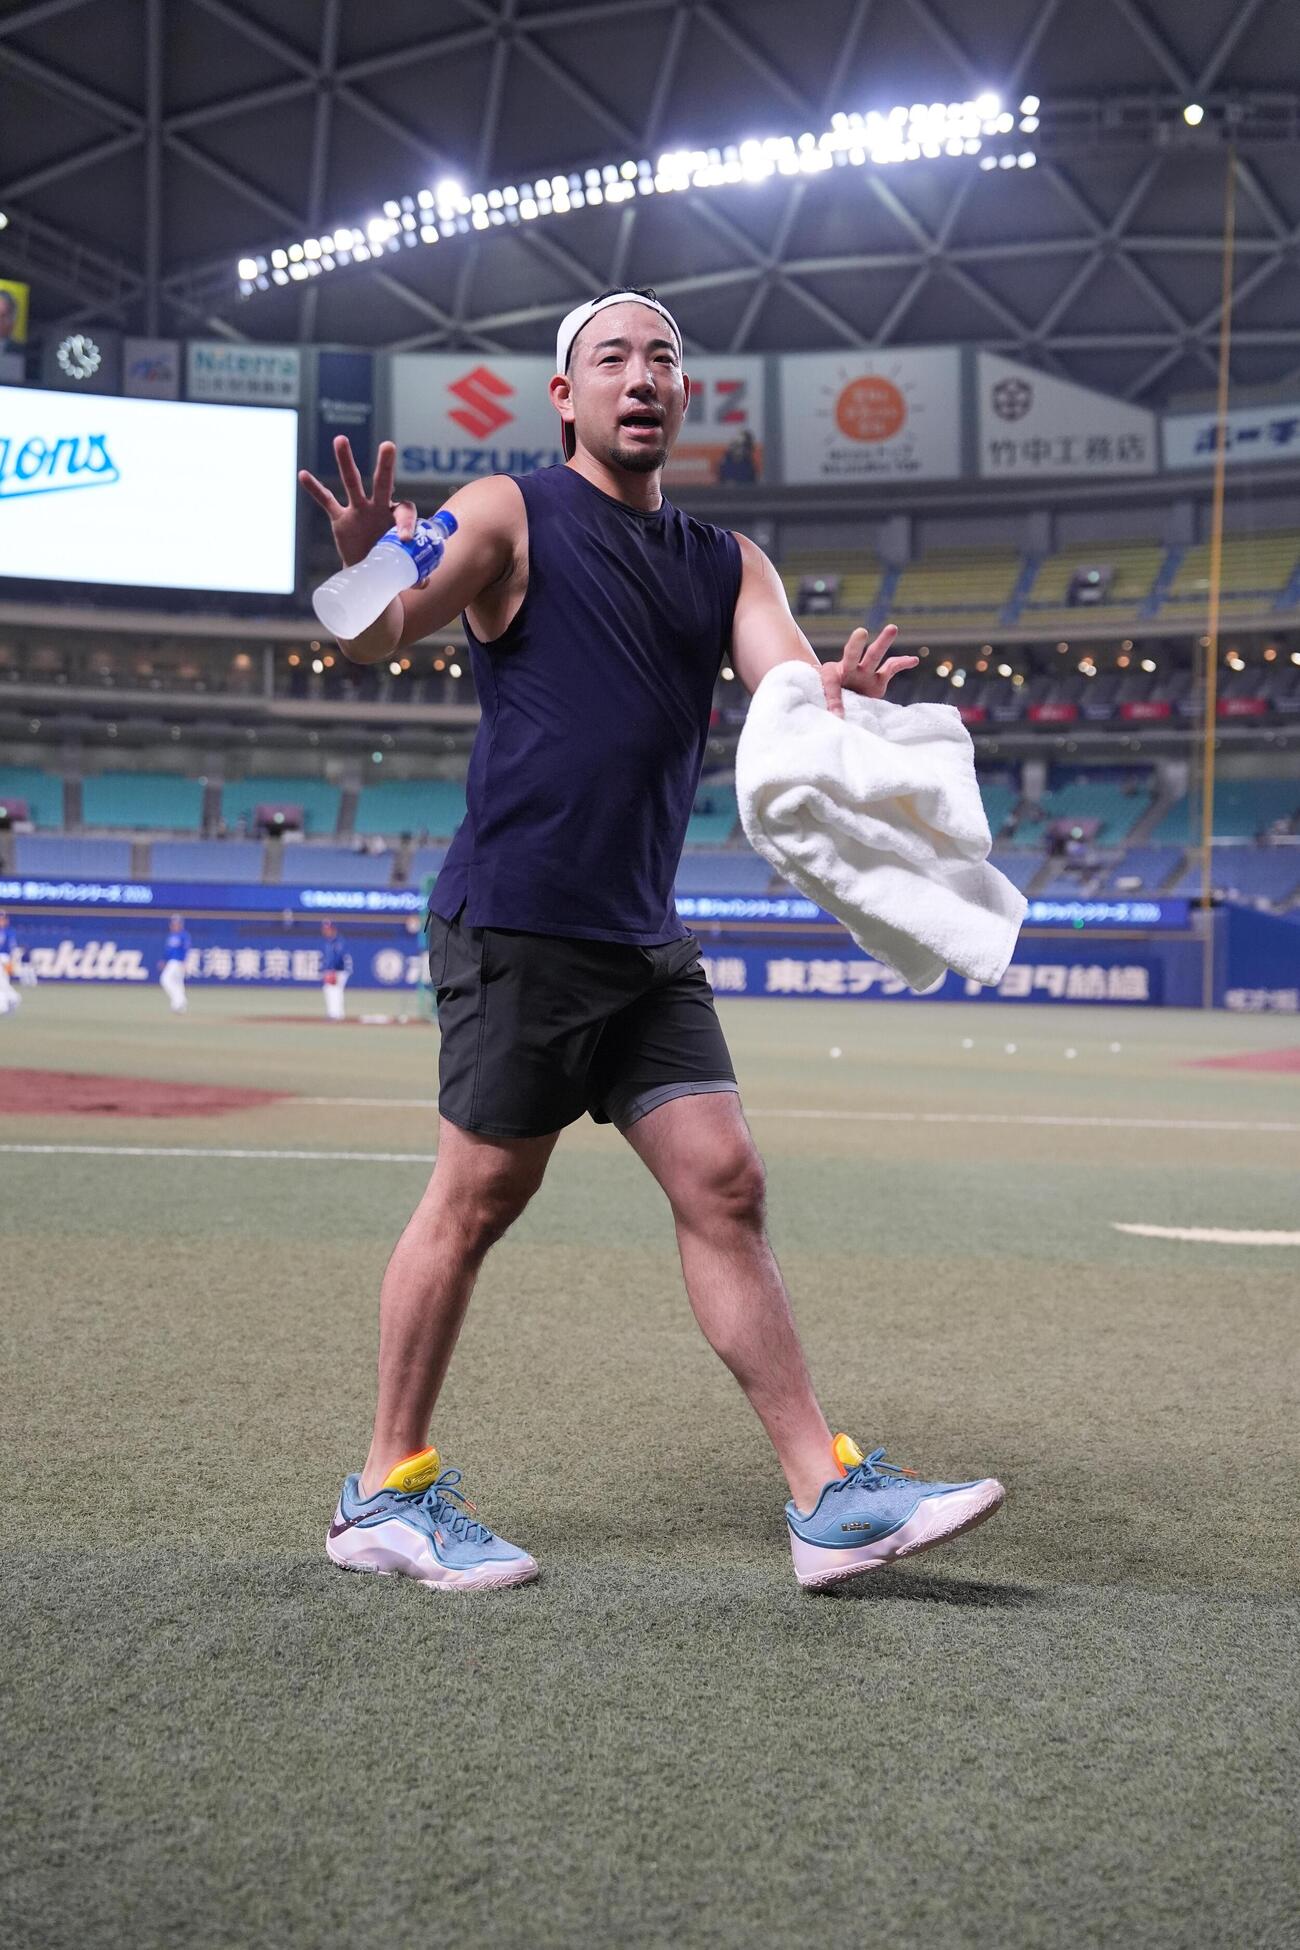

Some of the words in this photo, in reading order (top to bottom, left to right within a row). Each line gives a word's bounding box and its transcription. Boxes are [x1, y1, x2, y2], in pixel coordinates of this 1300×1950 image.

[990, 434, 1144, 466] 竹中工務店
